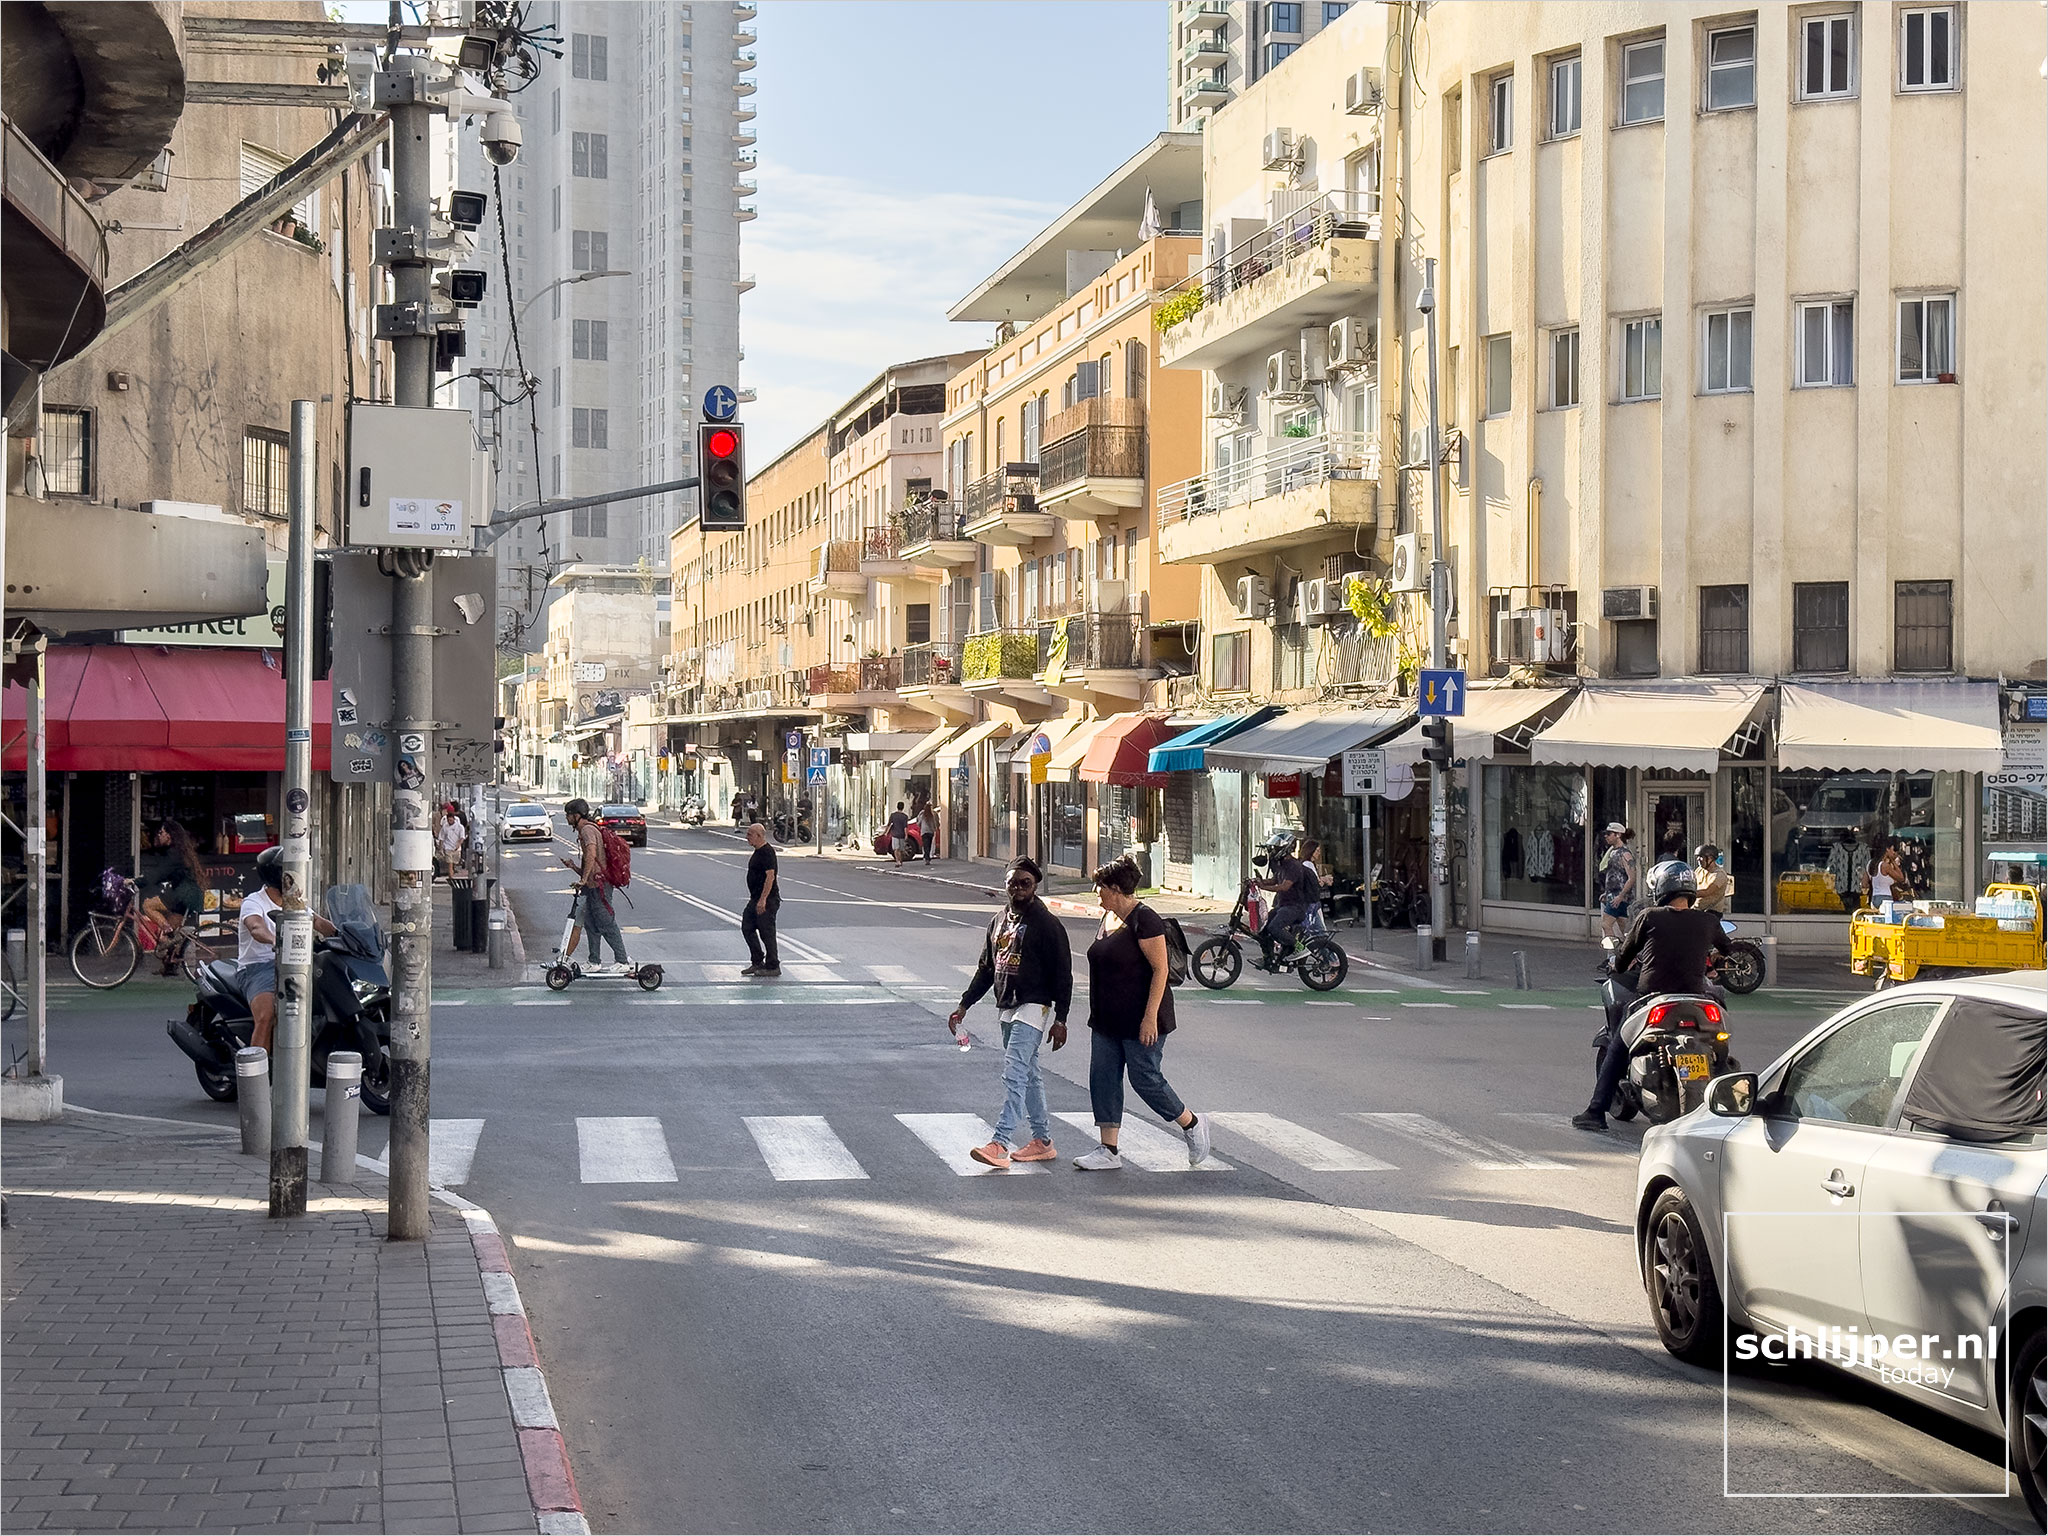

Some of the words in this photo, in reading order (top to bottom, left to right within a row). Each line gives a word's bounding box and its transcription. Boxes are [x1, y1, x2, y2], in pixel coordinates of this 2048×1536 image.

[273, 615, 285, 625] 24/
[614, 669, 630, 679] FIX
[1987, 773, 2047, 784] 050-97
